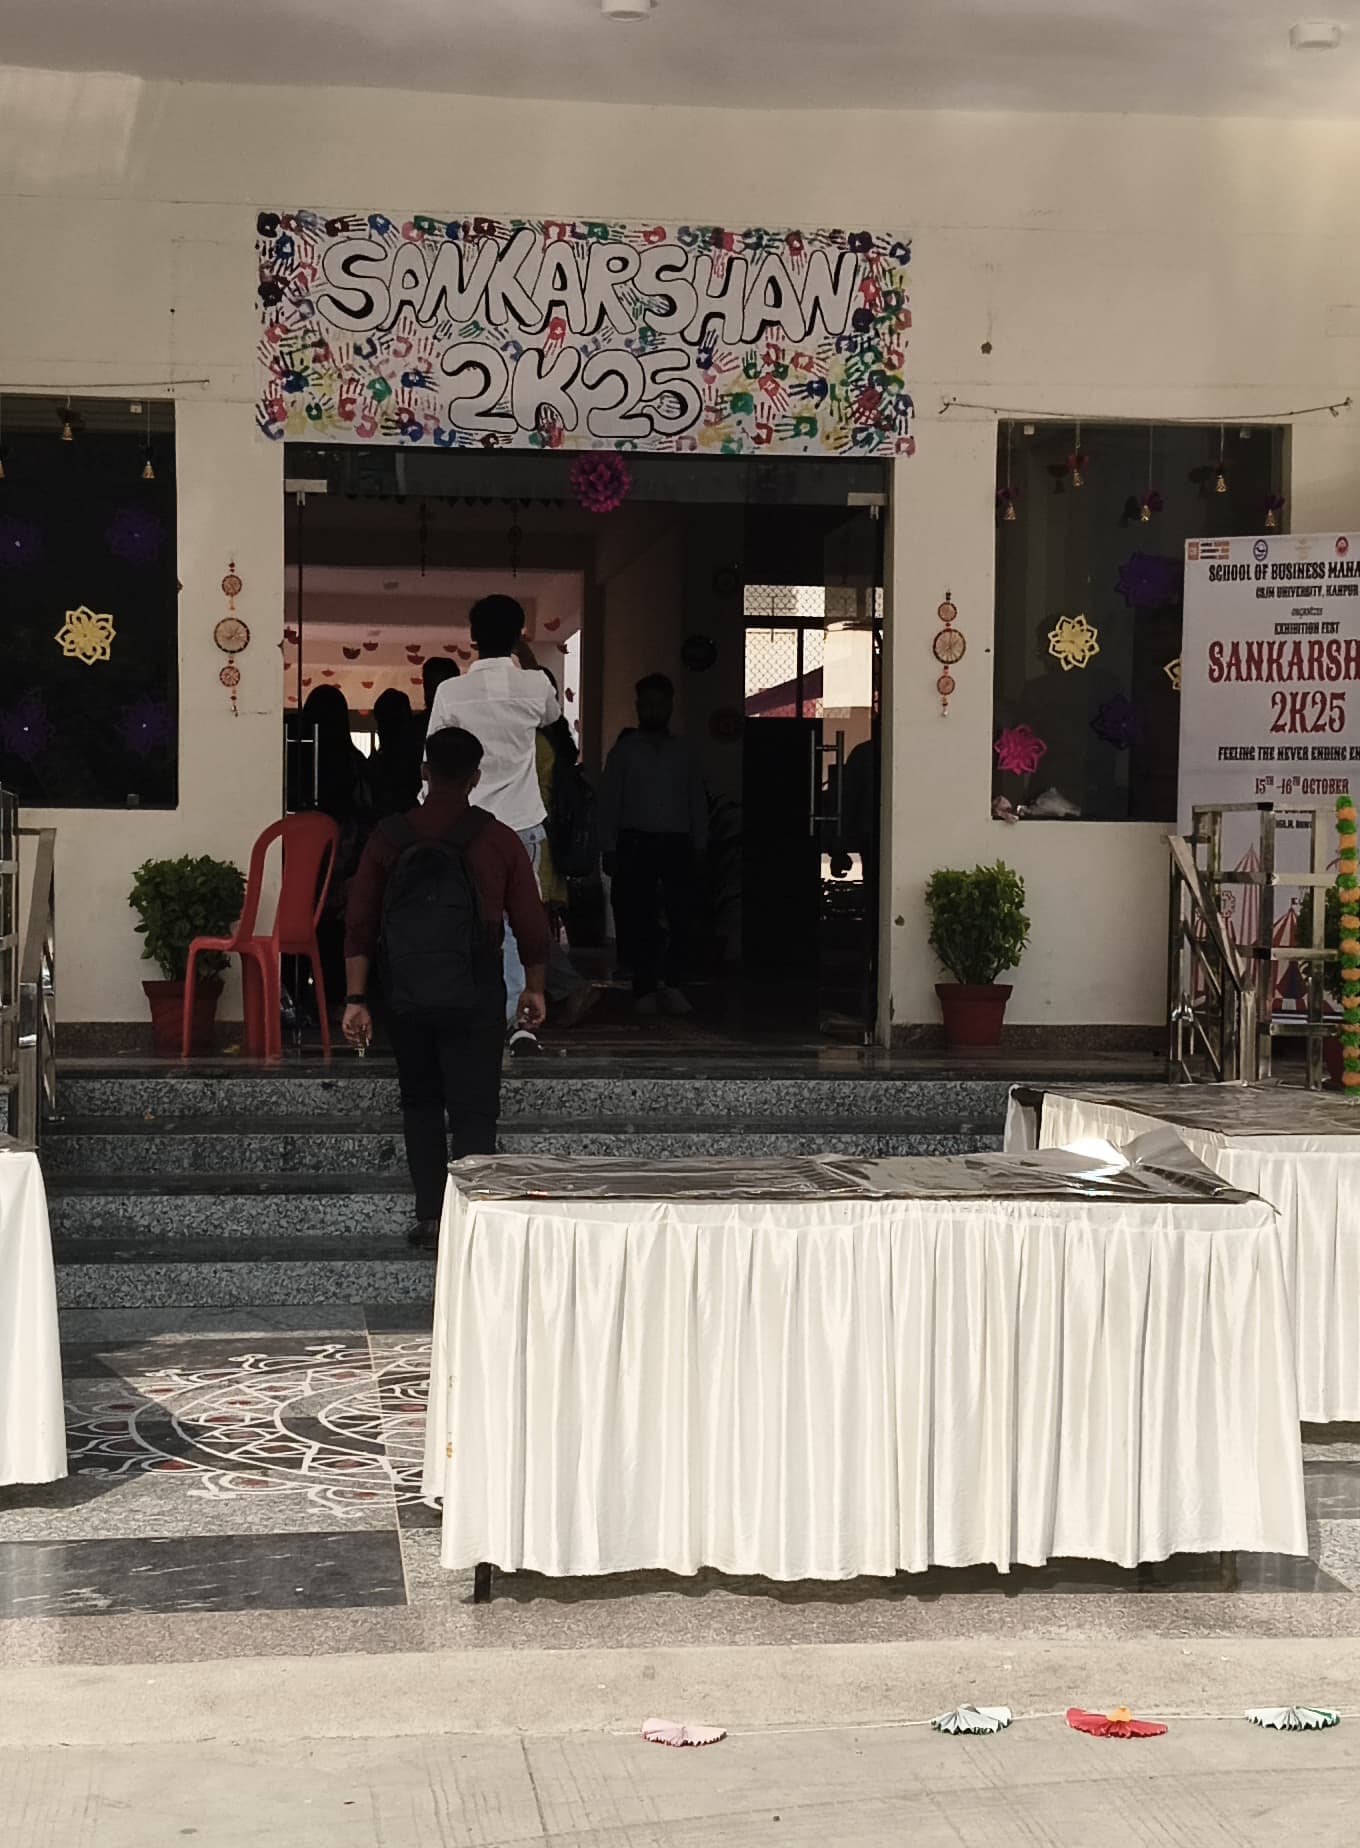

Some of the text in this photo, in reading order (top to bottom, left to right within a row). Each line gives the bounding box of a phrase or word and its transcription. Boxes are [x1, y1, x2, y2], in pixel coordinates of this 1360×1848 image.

[317, 228, 857, 345] SANKARSHAN
[440, 341, 704, 439] 2K25
[1209, 563, 1251, 582] SCHOOL
[1254, 564, 1269, 580] OF
[1271, 561, 1326, 580] BUSINESS
[1321, 622, 1340, 634] FEST
[1270, 690, 1346, 733] 2K25
[1218, 746, 1255, 761] FEELING
[1257, 746, 1275, 761] THE
[1277, 746, 1308, 761] NEVER
[1311, 746, 1347, 760] ENDING
[1302, 778, 1349, 795] OCTOBER
